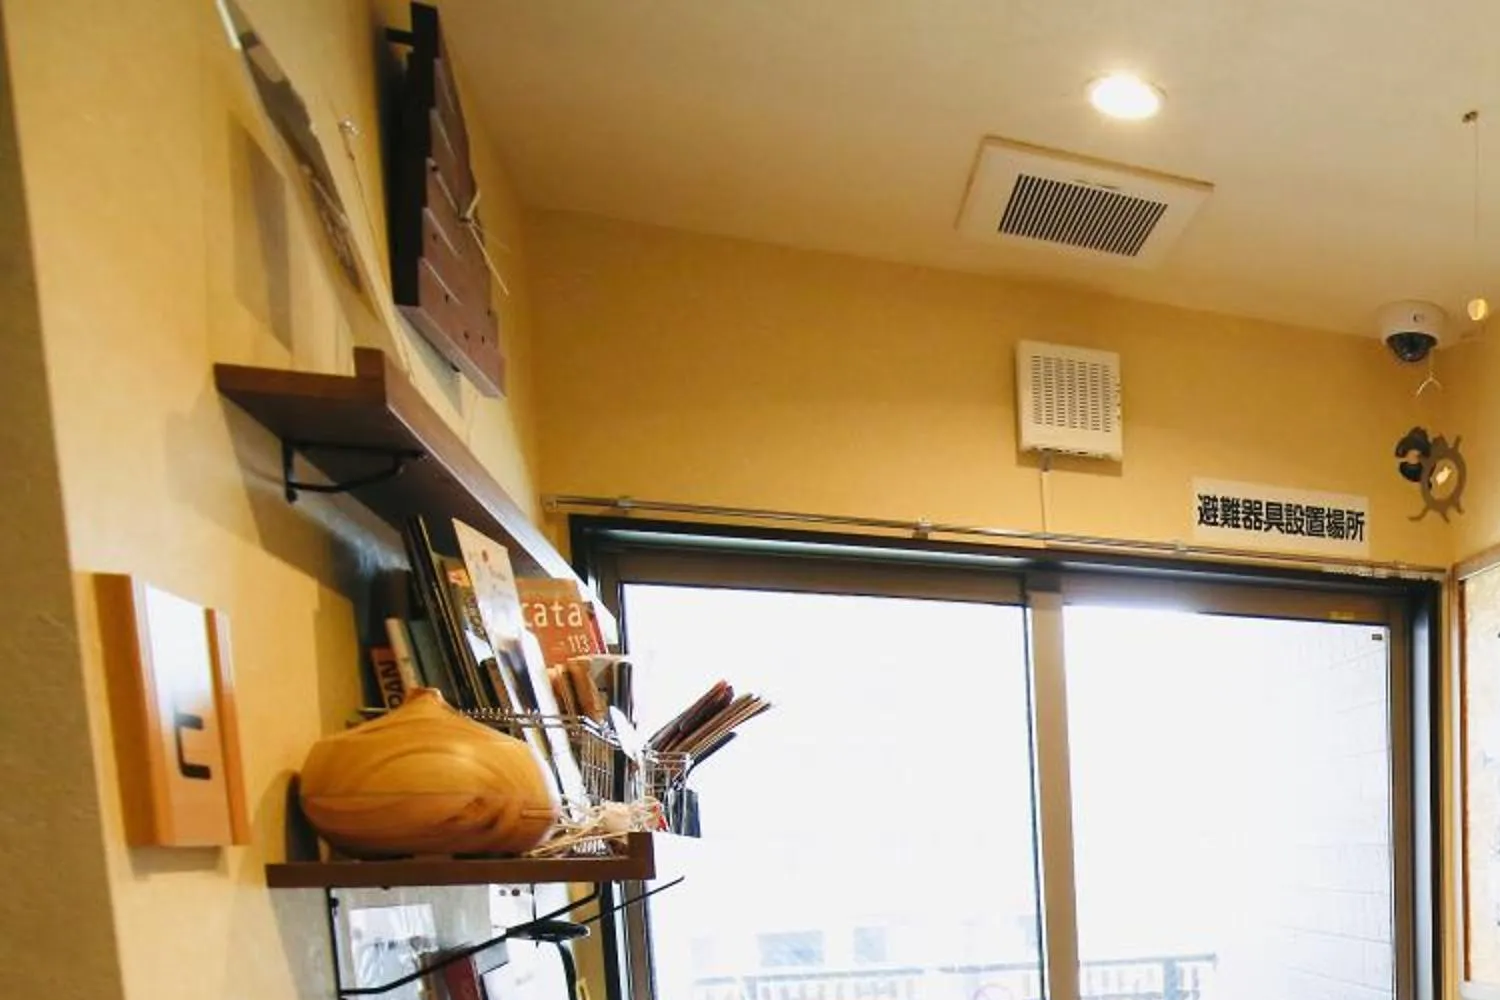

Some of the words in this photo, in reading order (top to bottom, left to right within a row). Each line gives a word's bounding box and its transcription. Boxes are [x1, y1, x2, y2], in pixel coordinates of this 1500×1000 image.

[1197, 493, 1365, 542] 避難器具設置場所
